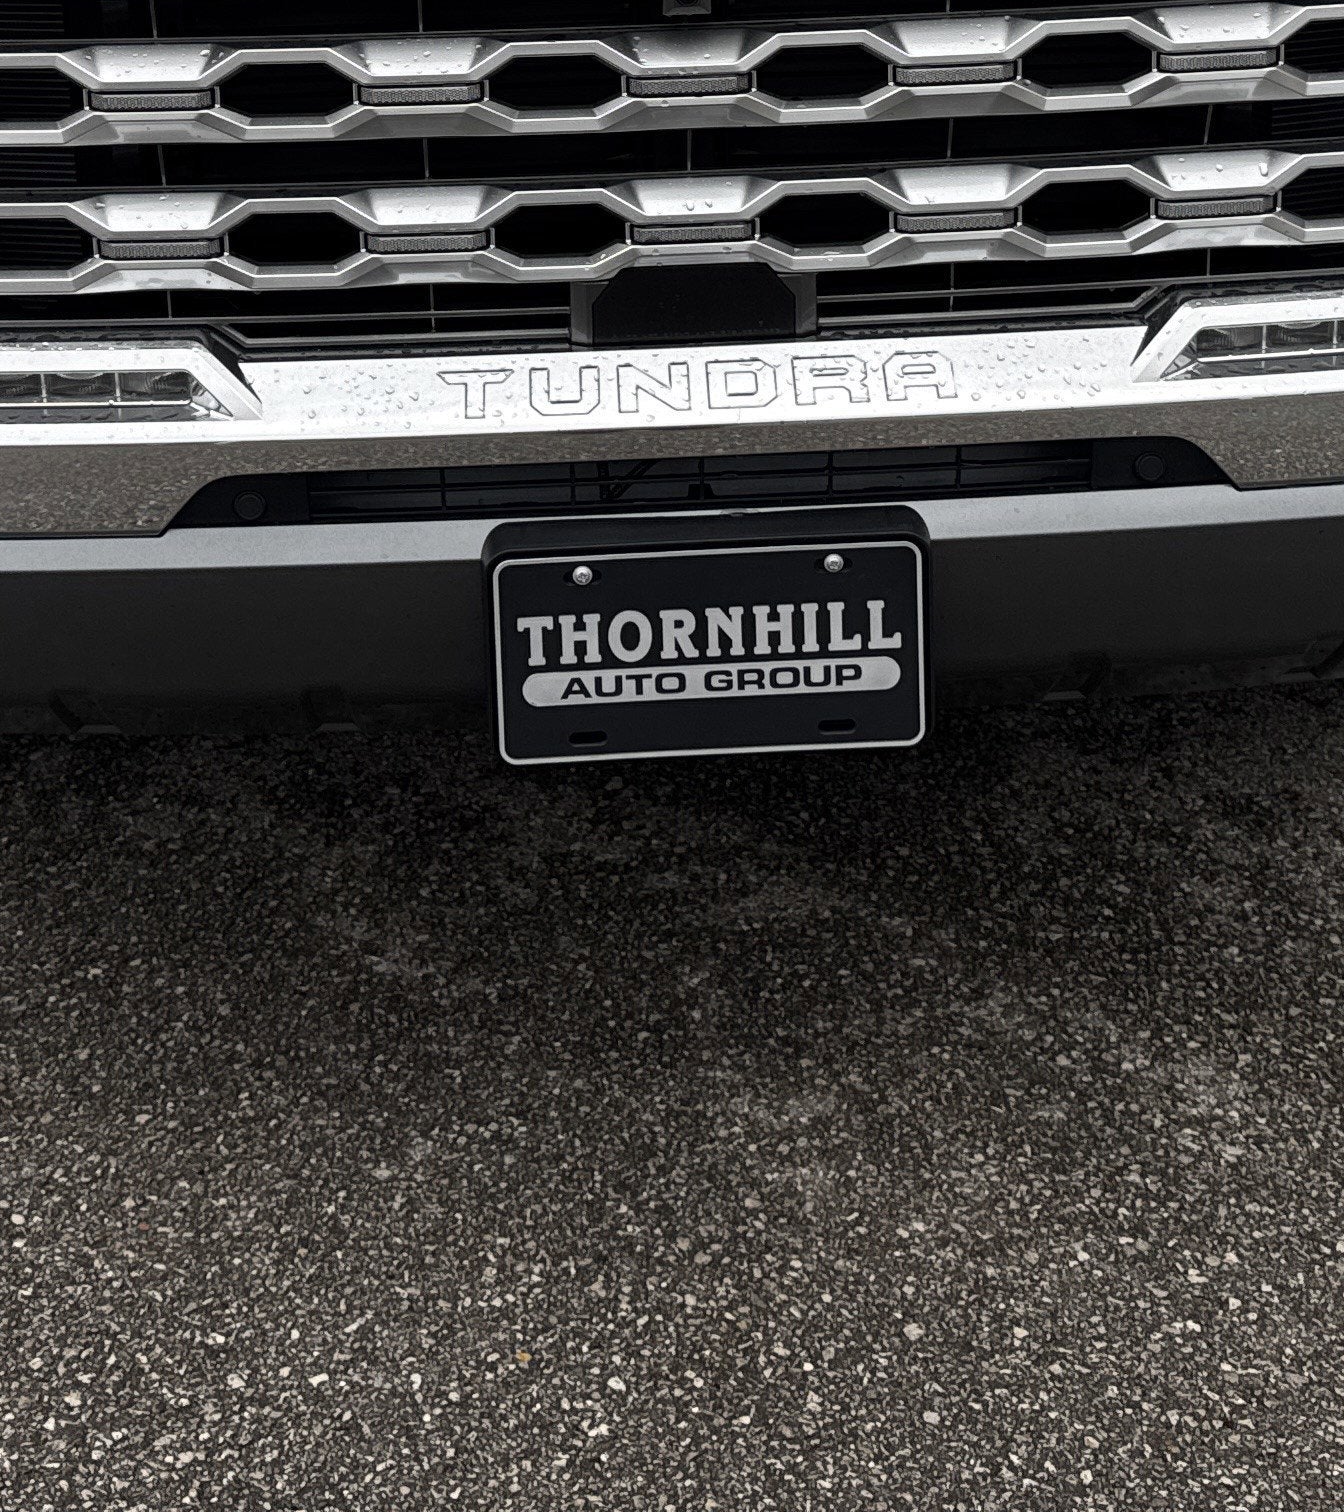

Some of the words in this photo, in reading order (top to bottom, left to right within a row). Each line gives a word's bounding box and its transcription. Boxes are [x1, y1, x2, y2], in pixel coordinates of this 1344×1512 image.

[437, 351, 958, 419] TUNDRA
[517, 599, 902, 666] THORNHILL
[560, 672, 687, 700] AUTO
[704, 664, 863, 692] GROUP
